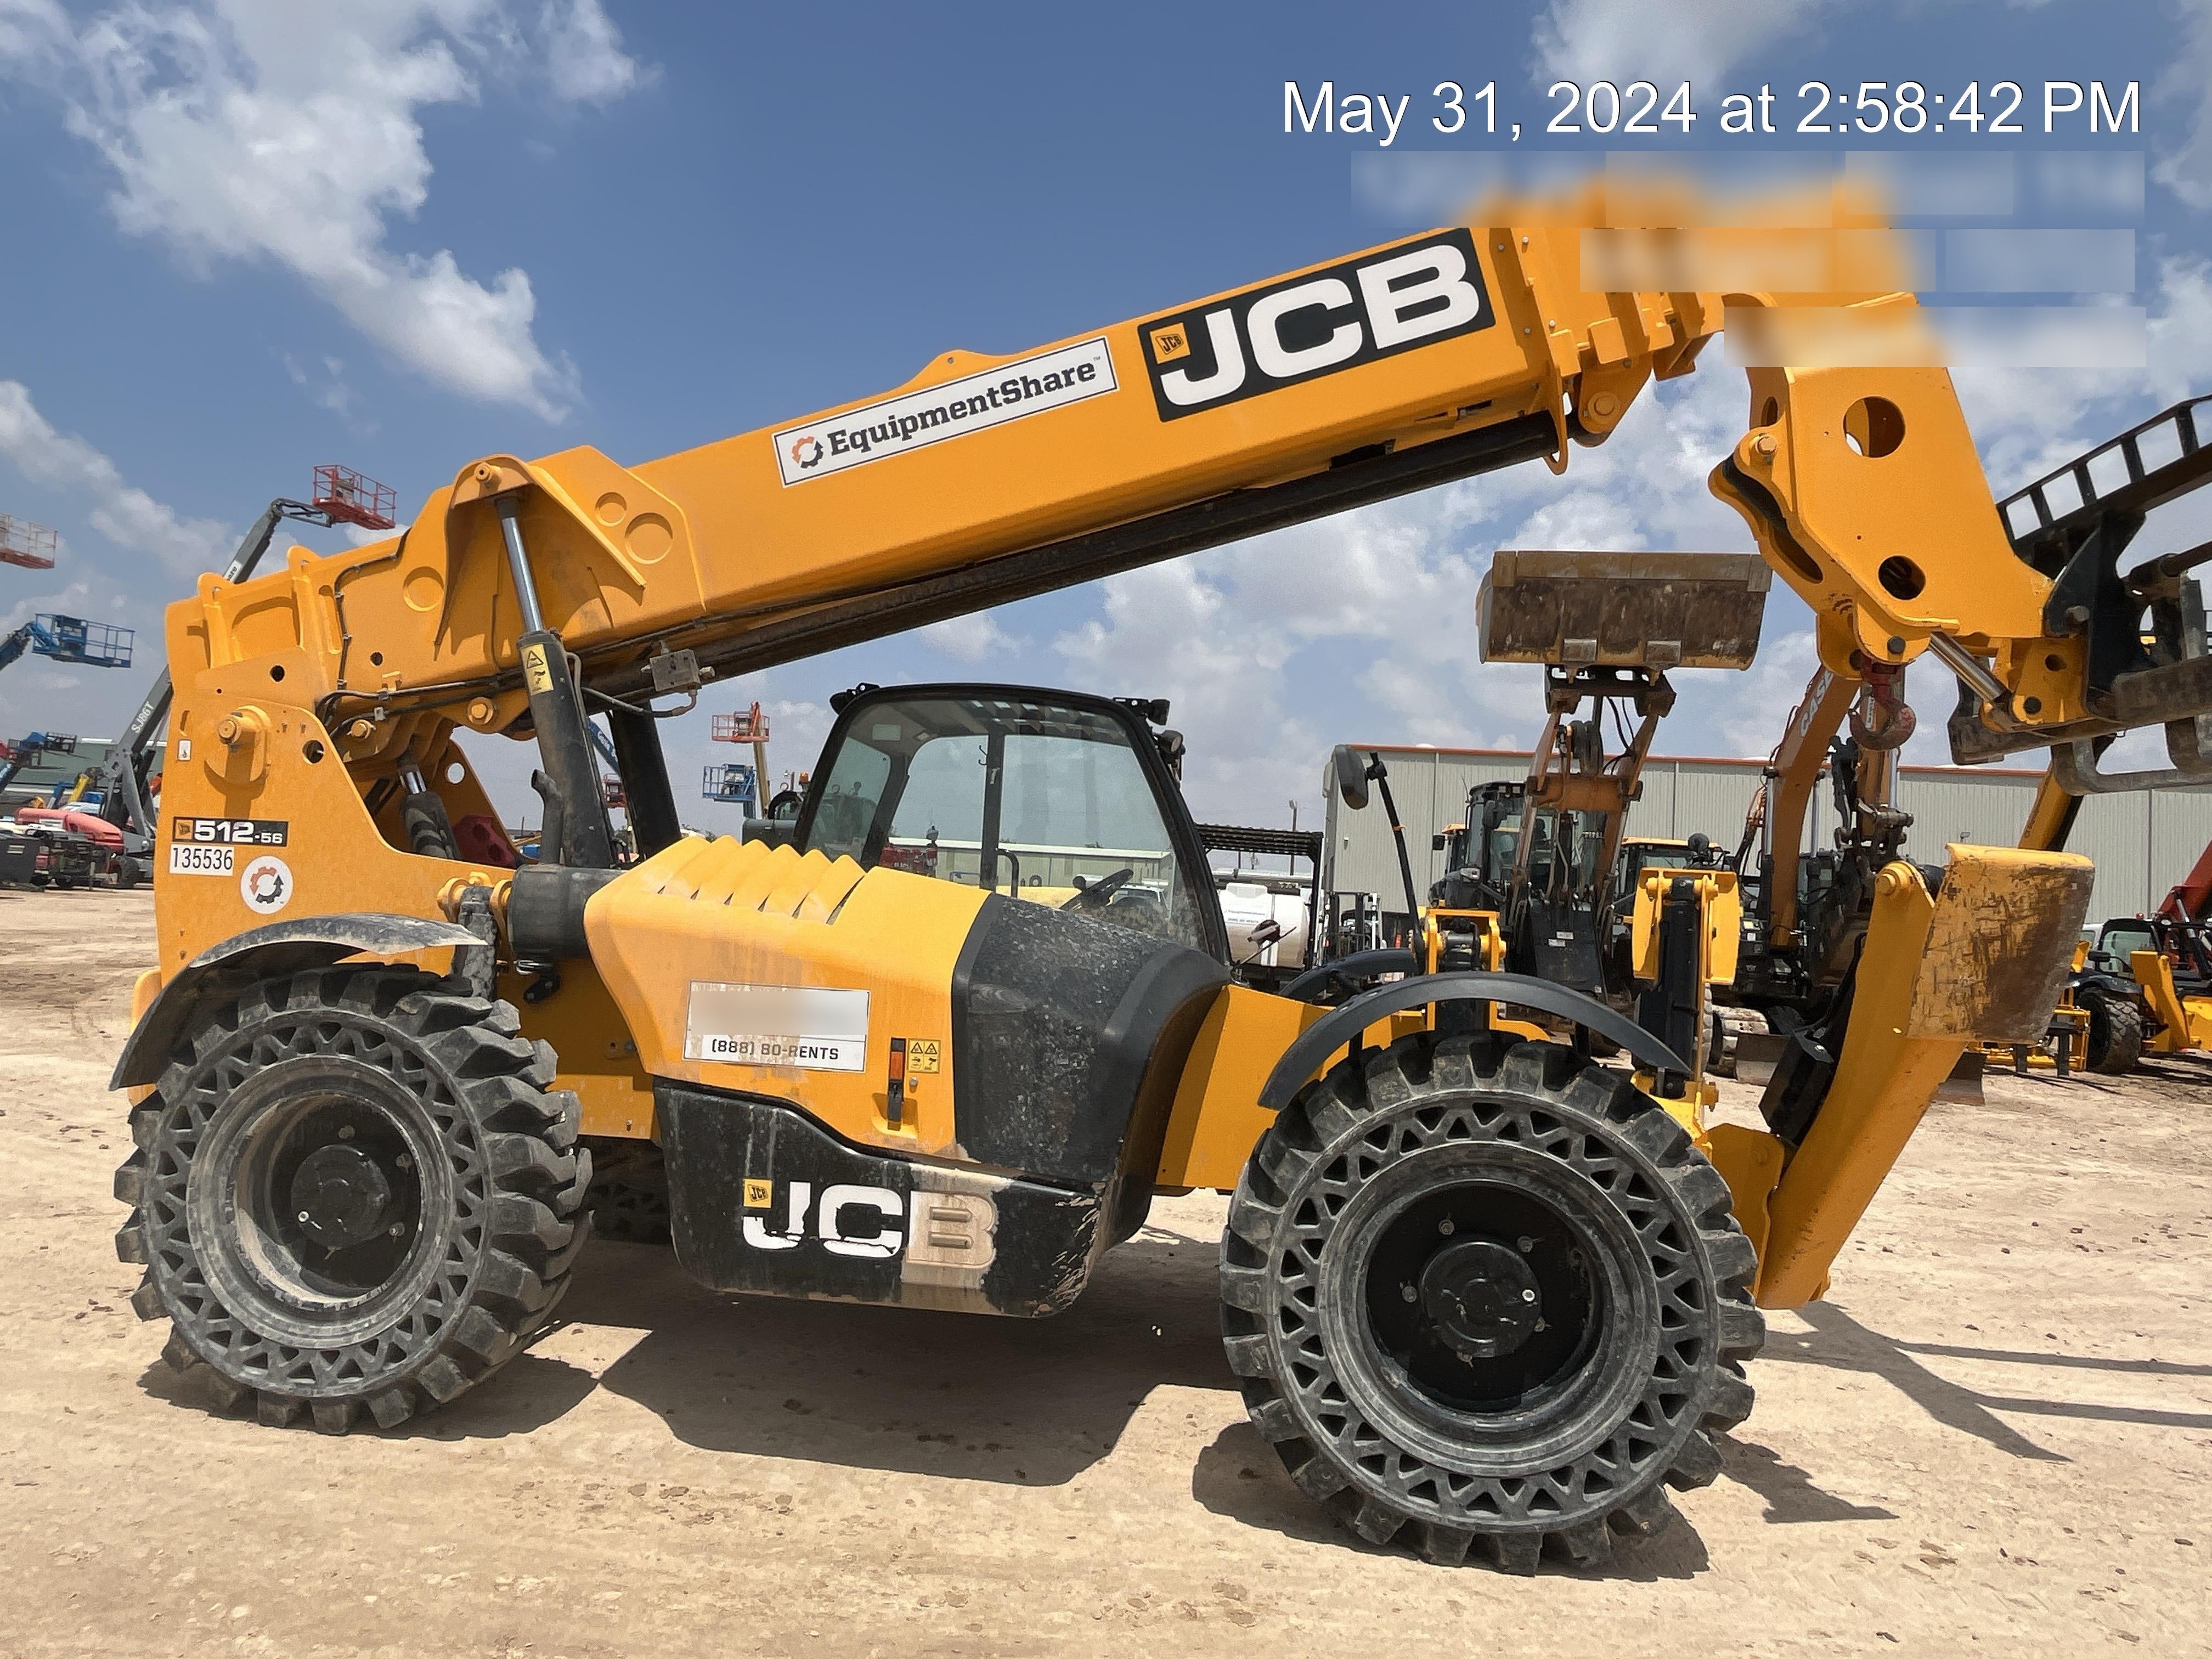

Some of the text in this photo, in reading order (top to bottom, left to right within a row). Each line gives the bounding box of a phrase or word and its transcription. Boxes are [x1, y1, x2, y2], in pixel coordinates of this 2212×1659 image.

[1160, 335, 1182, 352] JCB
[1161, 245, 1479, 405] JCB
[827, 363, 1096, 456] EquipmentShare
[173, 848, 233, 871] 135536
[712, 1039, 755, 1056] (888)
[743, 1181, 996, 1269] JCB
